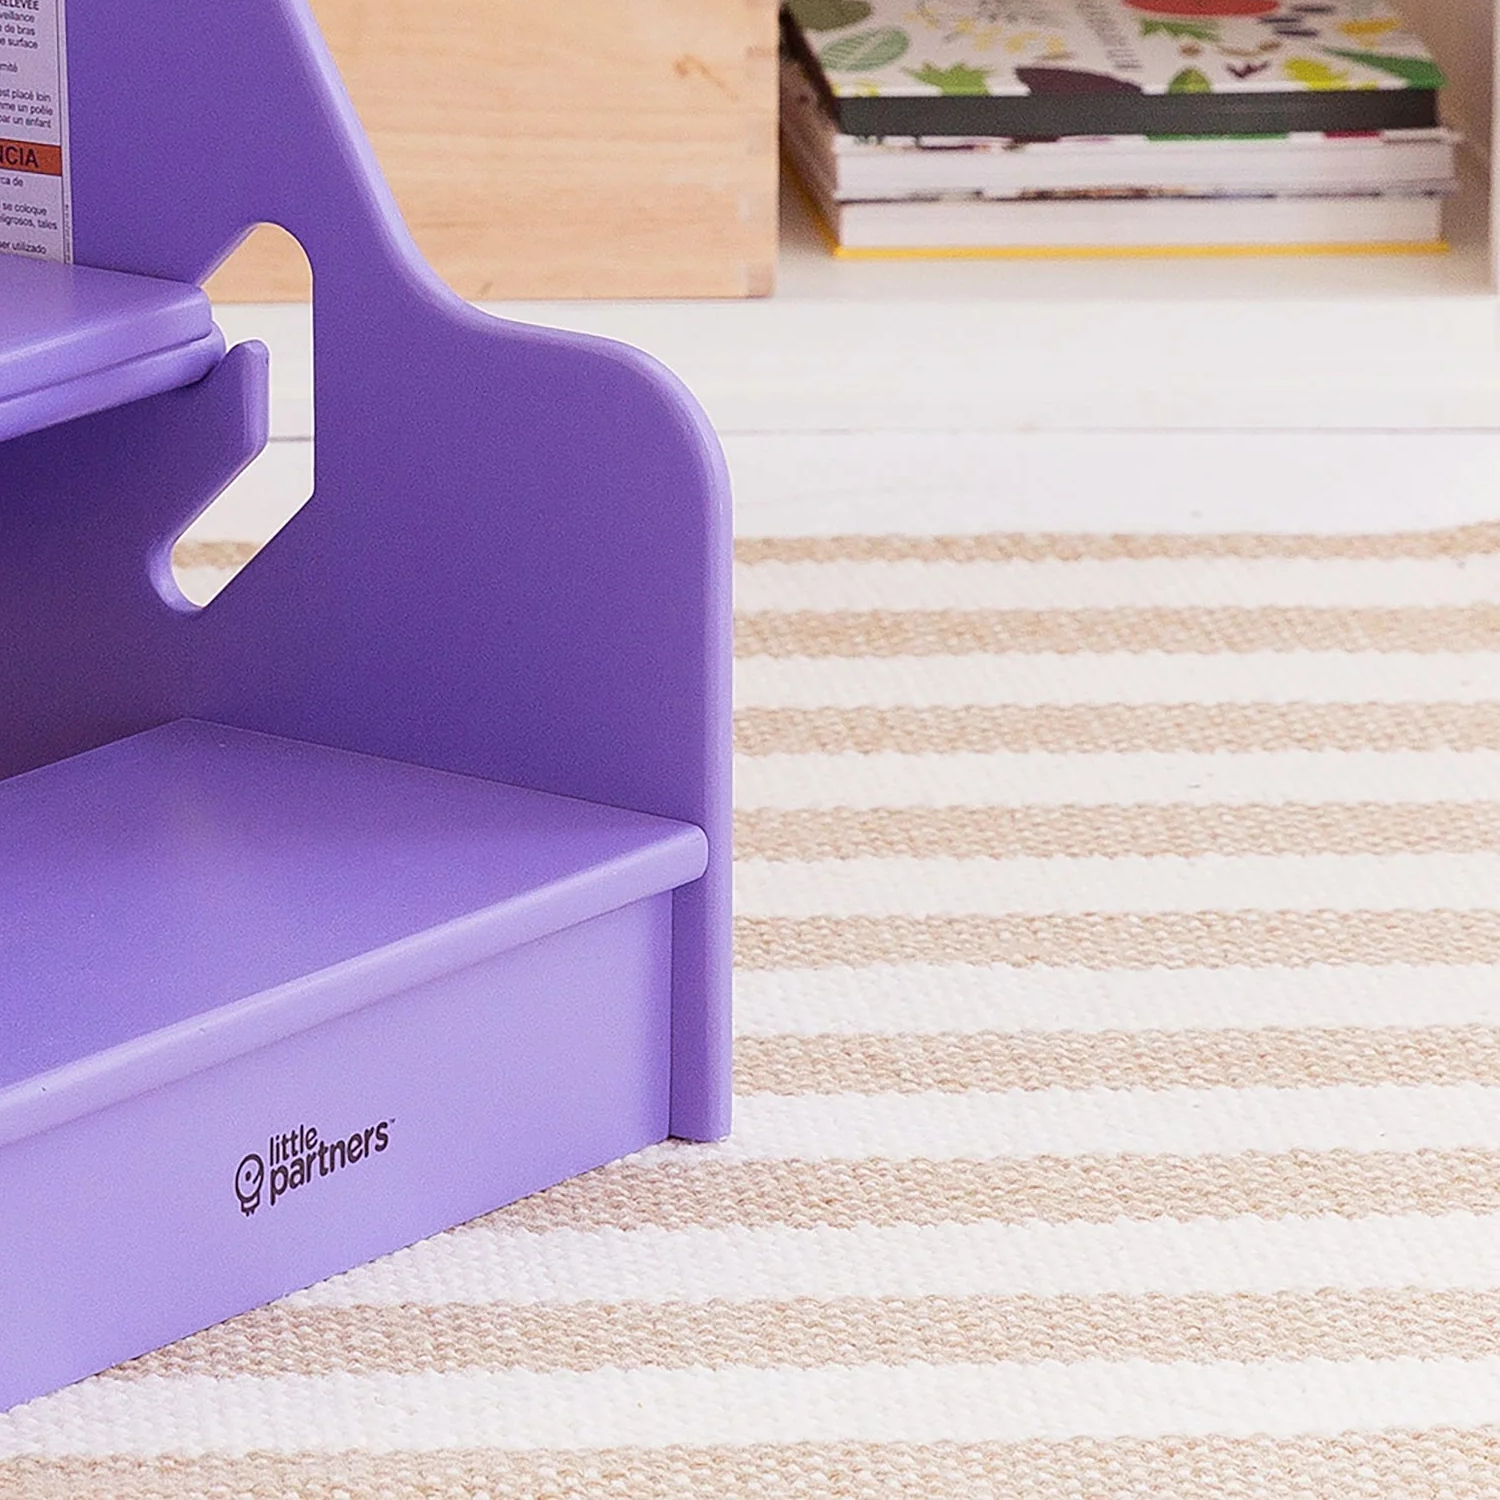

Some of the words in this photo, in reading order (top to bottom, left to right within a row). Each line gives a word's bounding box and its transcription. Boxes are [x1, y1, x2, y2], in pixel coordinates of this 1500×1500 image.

[4, 23, 15, 33] de
[16, 24, 35, 36] bras
[7, 38, 38, 49] surface
[11, 89, 34, 100] placé
[36, 92, 51, 102] loin
[17, 104, 28, 112] un
[12, 117, 23, 125] un
[25, 118, 51, 128] enfant
[12, 177, 23, 187] de
[2, 202, 12, 211] se
[14, 204, 47, 216] coloque
[37, 219, 57, 230] tales
[12, 242, 46, 254] utilizado
[270, 1124, 318, 1167] little
[270, 1121, 389, 1207] partners
